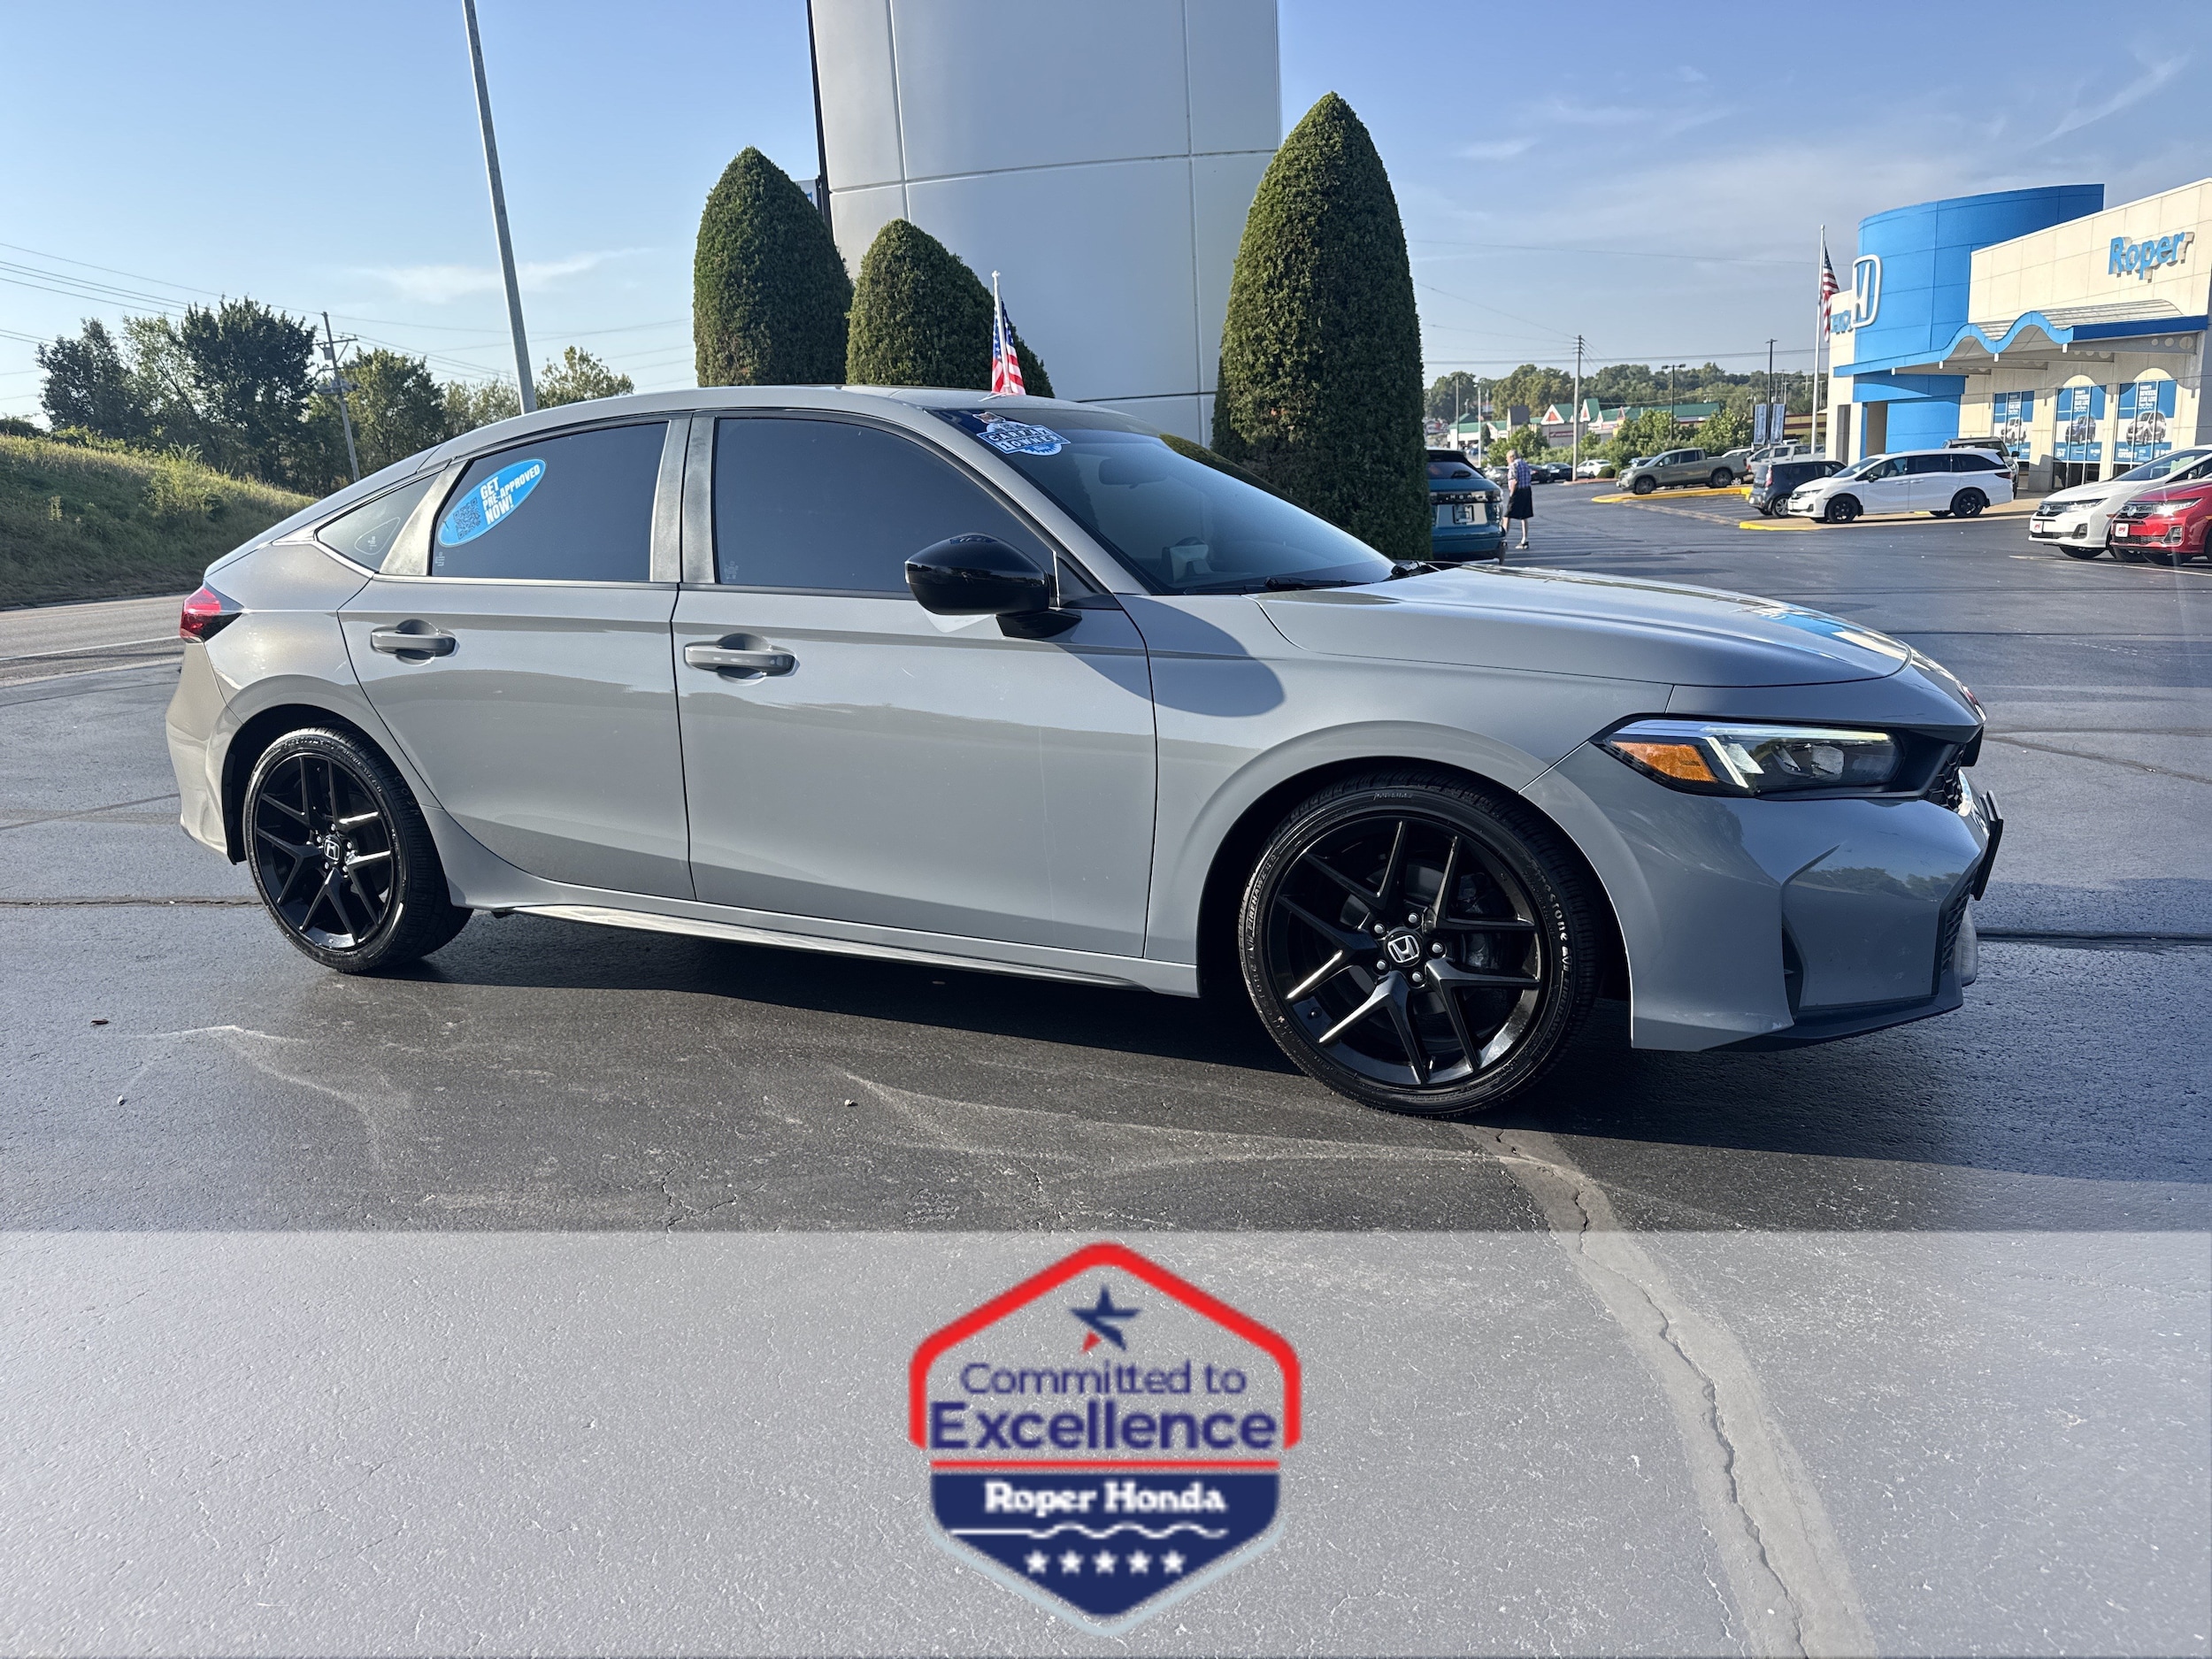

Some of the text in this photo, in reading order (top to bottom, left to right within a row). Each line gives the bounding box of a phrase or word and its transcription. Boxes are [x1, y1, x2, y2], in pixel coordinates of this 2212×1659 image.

[2108, 232, 2187, 280] Roper
[988, 426, 1052, 442] CARFAX
[1010, 434, 1060, 448] OWNER
[480, 476, 499, 500] GET
[482, 464, 540, 511] PRE-APPROVED
[485, 494, 514, 526] NOW!
